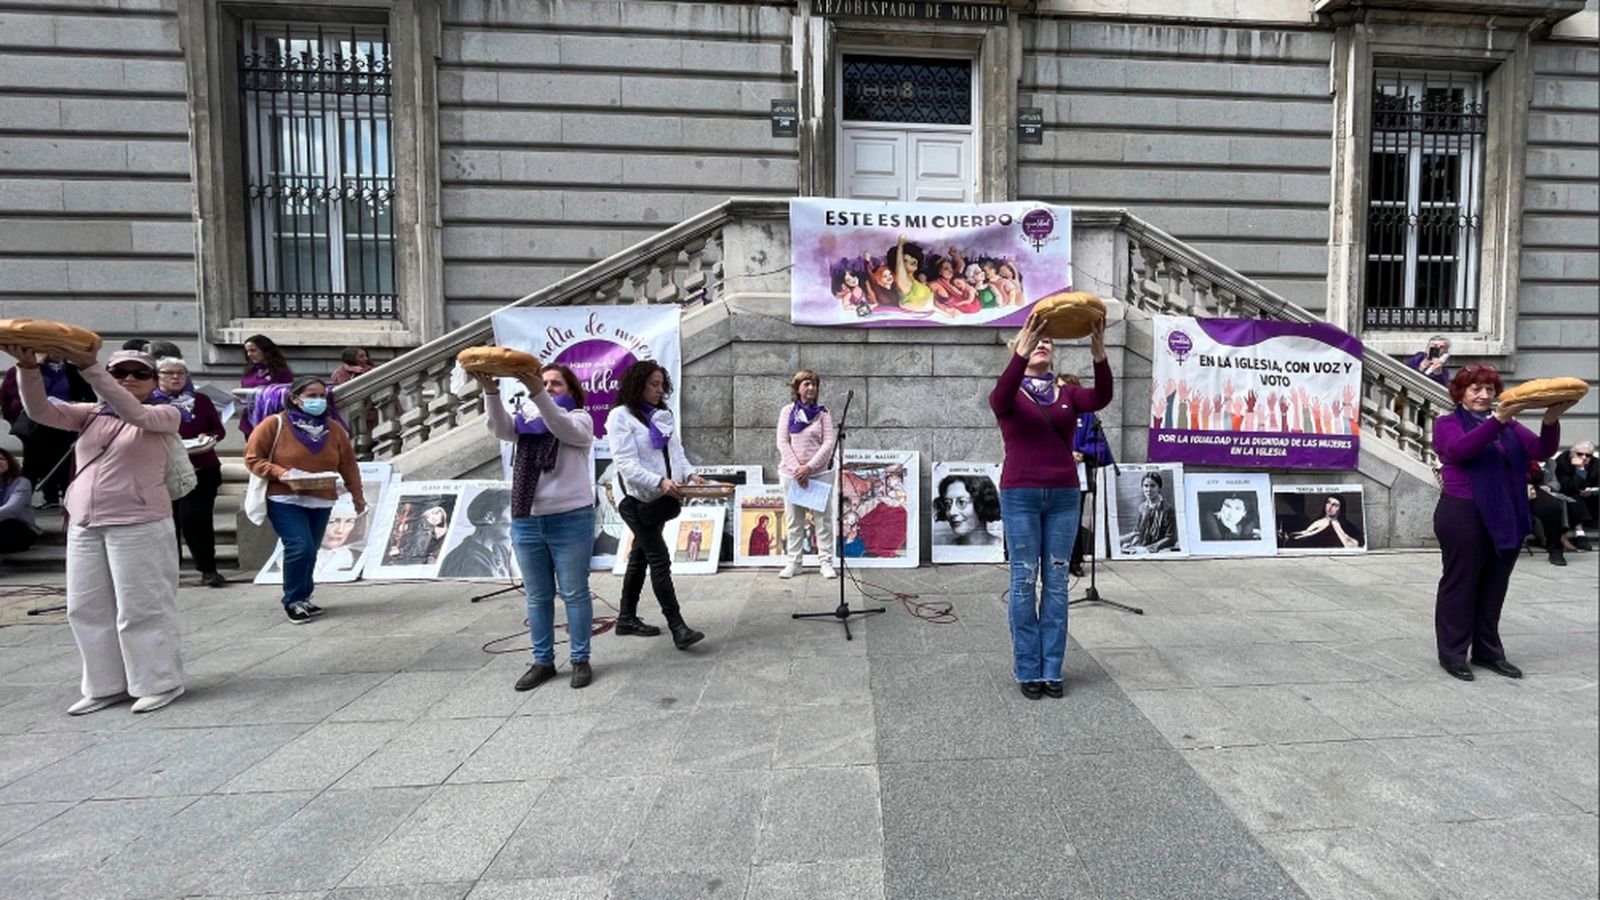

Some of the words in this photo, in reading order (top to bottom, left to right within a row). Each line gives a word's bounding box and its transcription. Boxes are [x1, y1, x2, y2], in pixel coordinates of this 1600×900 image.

[816, 0, 916, 17] ARZOBISPADO
[925, 4, 942, 19] DE
[951, 5, 1003, 22] MADRID
[902, 81, 913, 98] 8
[826, 210, 873, 226] ESTE
[878, 213, 901, 228] ES
[905, 215, 926, 228] MI
[932, 213, 1013, 228] CUERPO
[584, 311, 607, 336] de
[1200, 354, 1215, 367] EN
[1218, 356, 1231, 368] LA
[1235, 357, 1283, 373] IGLESIA,
[1285, 361, 1310, 373] CON
[1313, 362, 1341, 374] VOZ
[1343, 362, 1352, 374] Y
[1259, 374, 1291, 387] VOTO
[1158, 434, 1176, 443] POR
[1177, 435, 1189, 444] LA
[1190, 435, 1231, 445] IGUALDAD
[1232, 437, 1239, 445] Y
[1240, 437, 1250, 446] LA
[1252, 437, 1289, 447] DIGNIDAD
[1291, 438, 1301, 447] DE
[1302, 438, 1317, 447] LAS
[1319, 439, 1352, 449] MUJERES
[1230, 446, 1241, 455] EN
[1243, 446, 1254, 456] LA
[1256, 447, 1287, 457] IGLESIA
